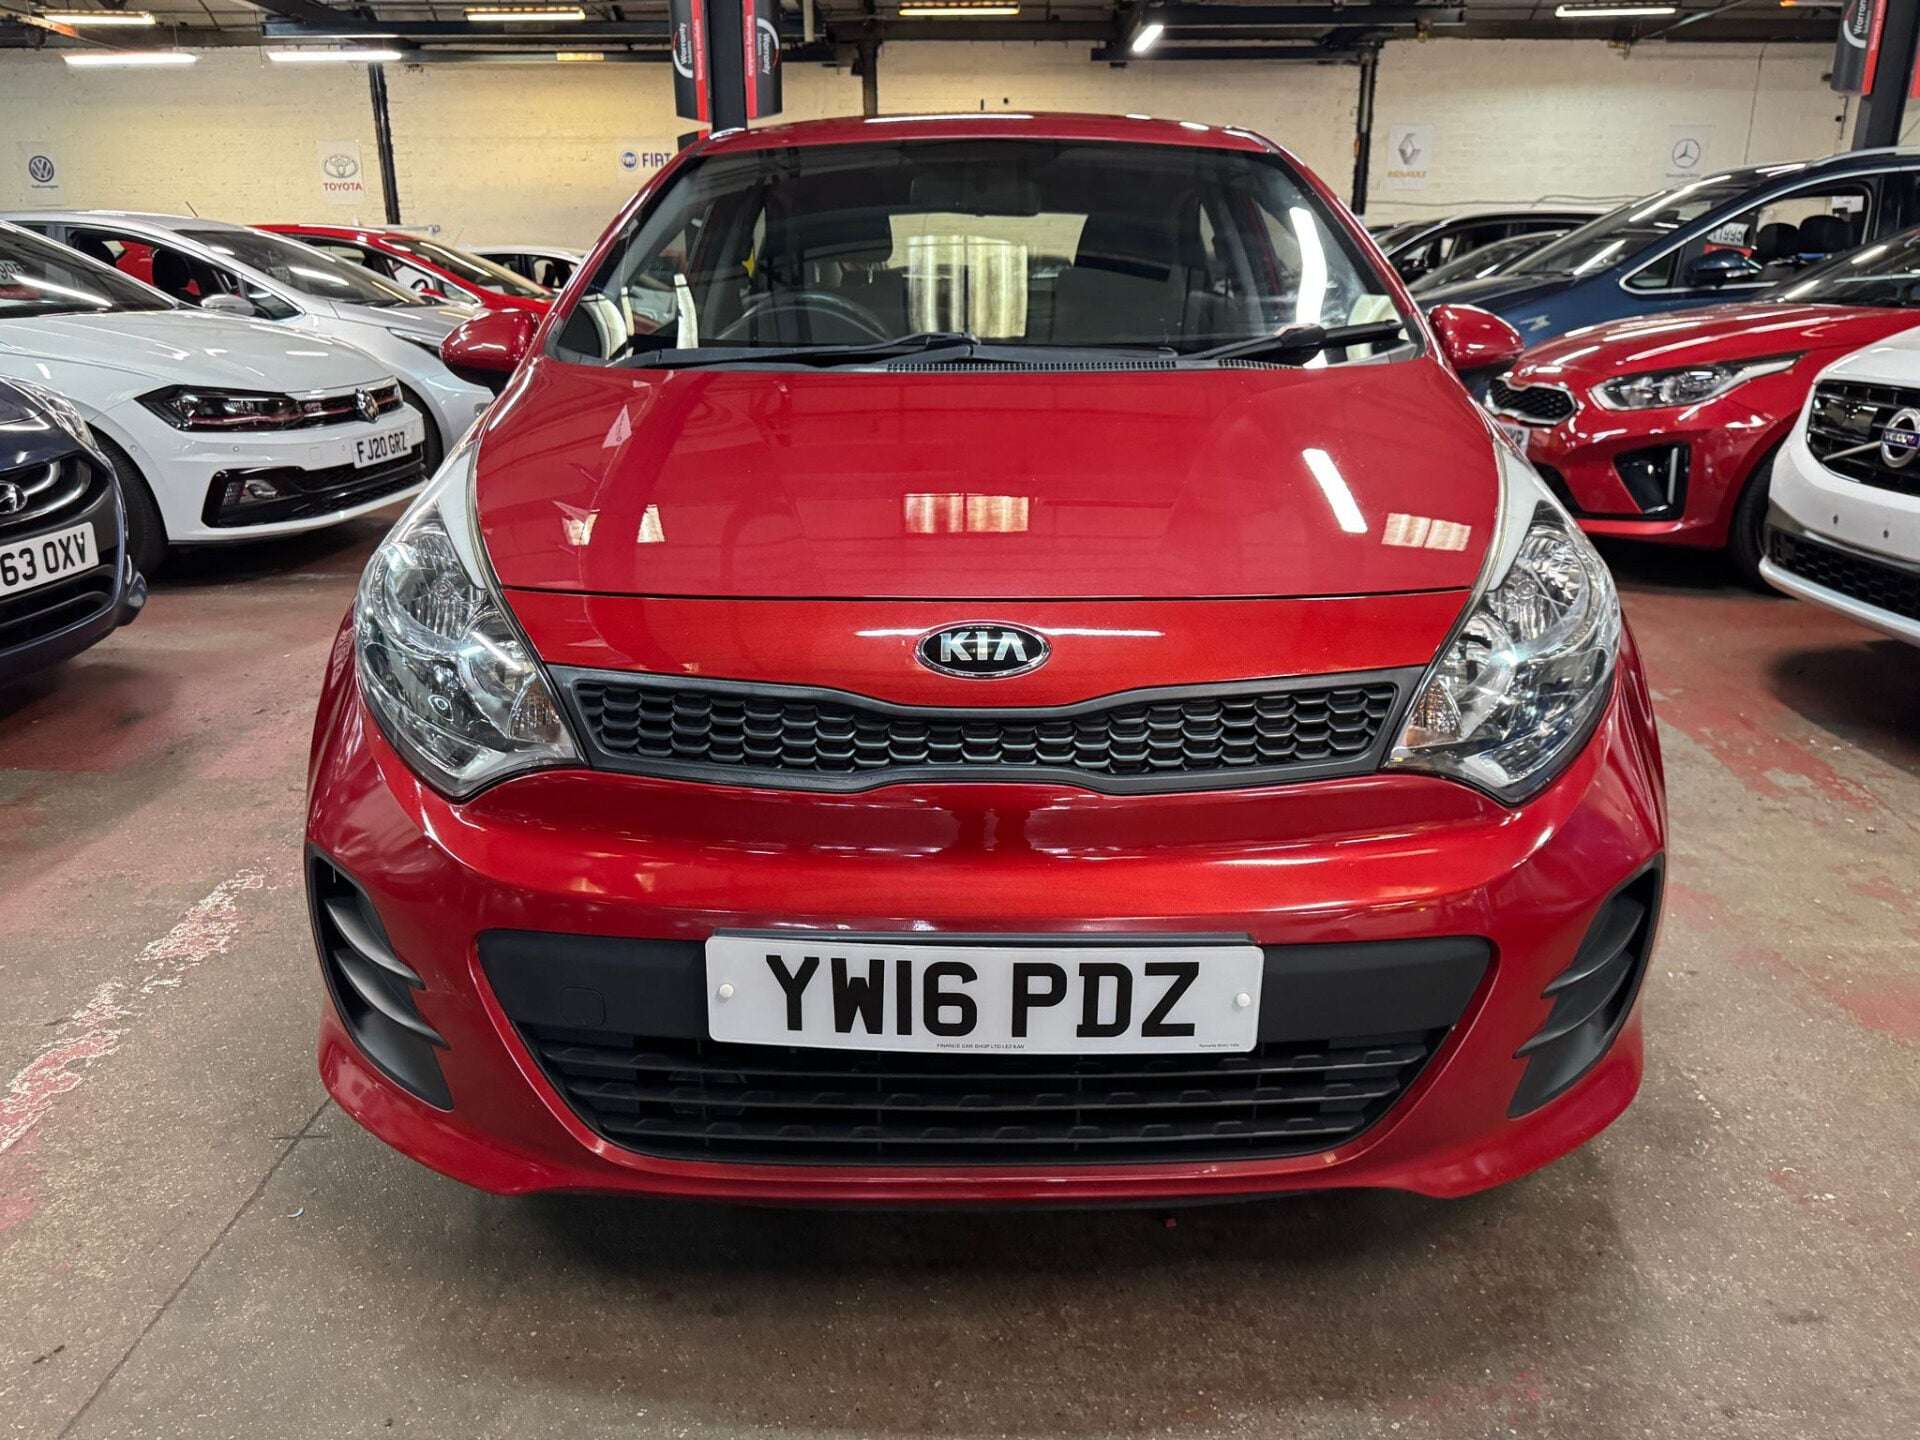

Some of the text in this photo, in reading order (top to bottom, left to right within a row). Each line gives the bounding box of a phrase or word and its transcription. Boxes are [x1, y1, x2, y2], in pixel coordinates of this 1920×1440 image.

[679, 22, 688, 65] Warranty
[762, 32, 771, 75] Warranty
[642, 152, 672, 168] FIAT
[322, 182, 363, 192] TOYOTA
[356, 431, 408, 464] FJ20 GRZ
[0, 531, 86, 587] 63 OXV
[939, 631, 1028, 662] KIA
[765, 954, 1200, 1038] YW16 PDZ
